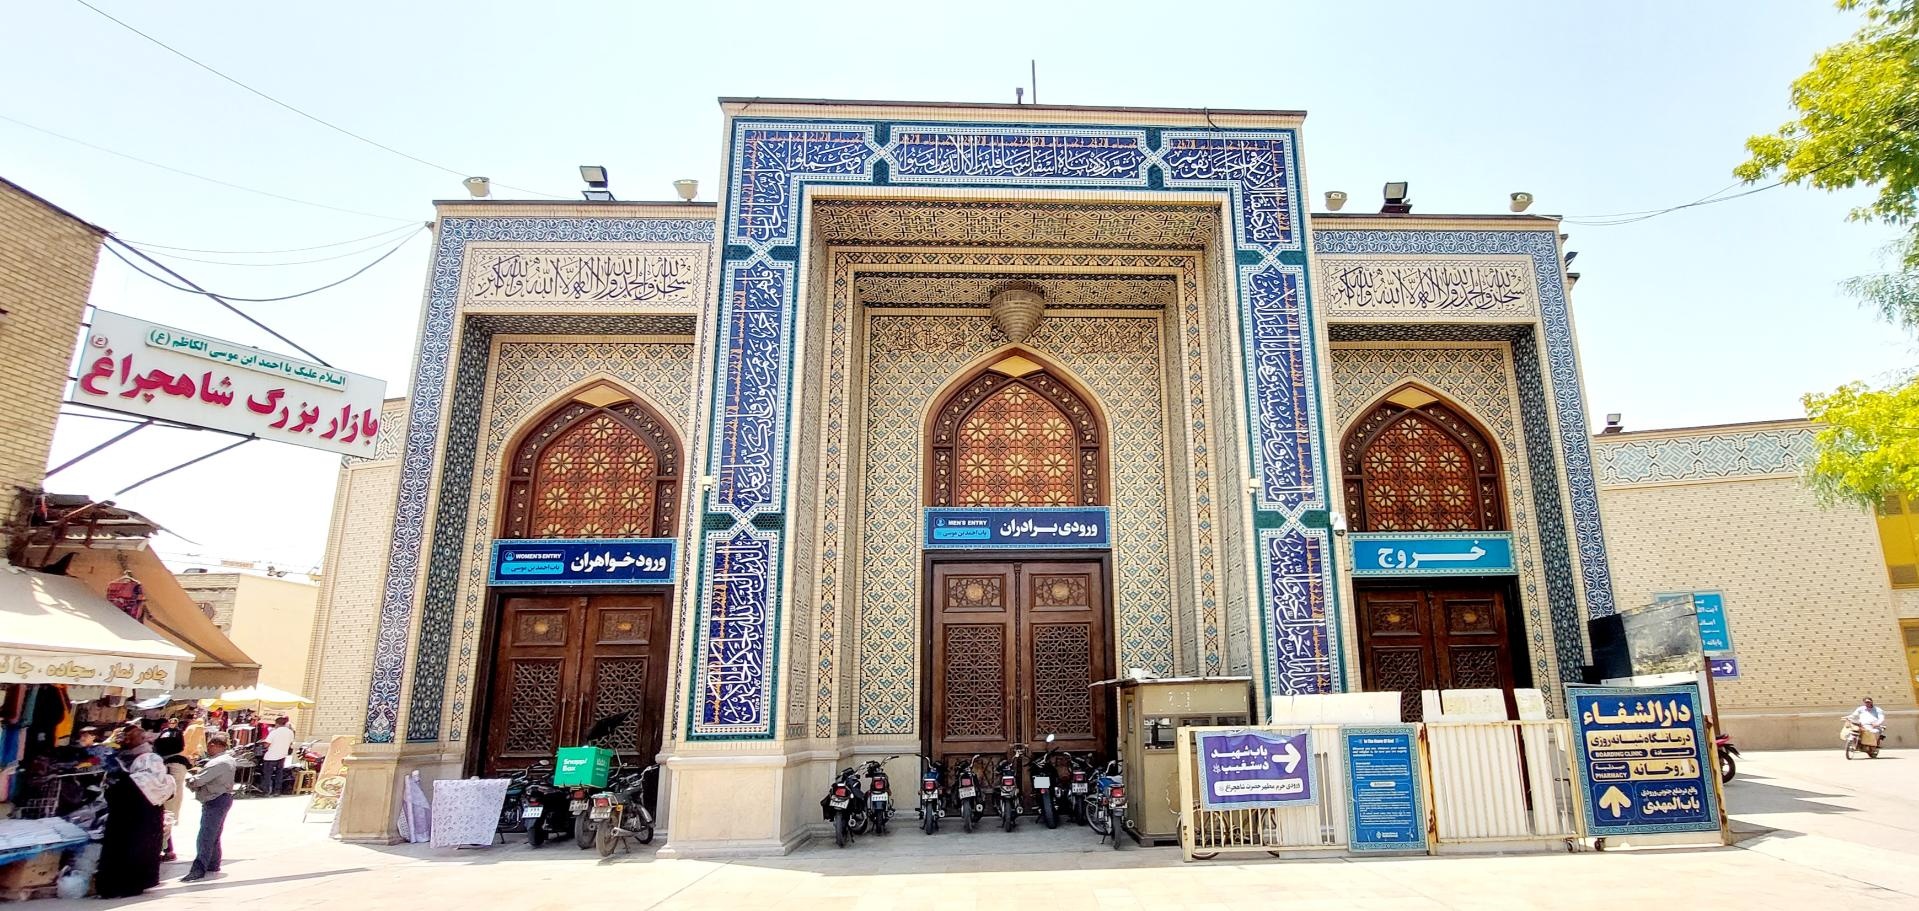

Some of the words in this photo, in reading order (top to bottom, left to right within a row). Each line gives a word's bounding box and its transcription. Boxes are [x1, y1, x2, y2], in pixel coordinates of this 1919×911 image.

[240, 354, 257, 367] ابن
[259, 358, 283, 370] احمد
[79, 347, 235, 408] شاهچراغ
[319, 372, 346, 387] السلام
[247, 387, 321, 434] بزرگ
[319, 401, 378, 446] بازار
[1000, 518, 1058, 537] برادران
[1059, 522, 1098, 536] ورودی
[571, 550, 636, 573] خواهران
[635, 554, 667, 572] ورود
[1378, 540, 1487, 569] خروج
[47, 660, 95, 682] سجاده
[104, 662, 134, 683] نماز
[1211, 745, 1251, 760] شهید
[1250, 744, 1268, 759] باب
[1681, 795, 1700, 813] باب
